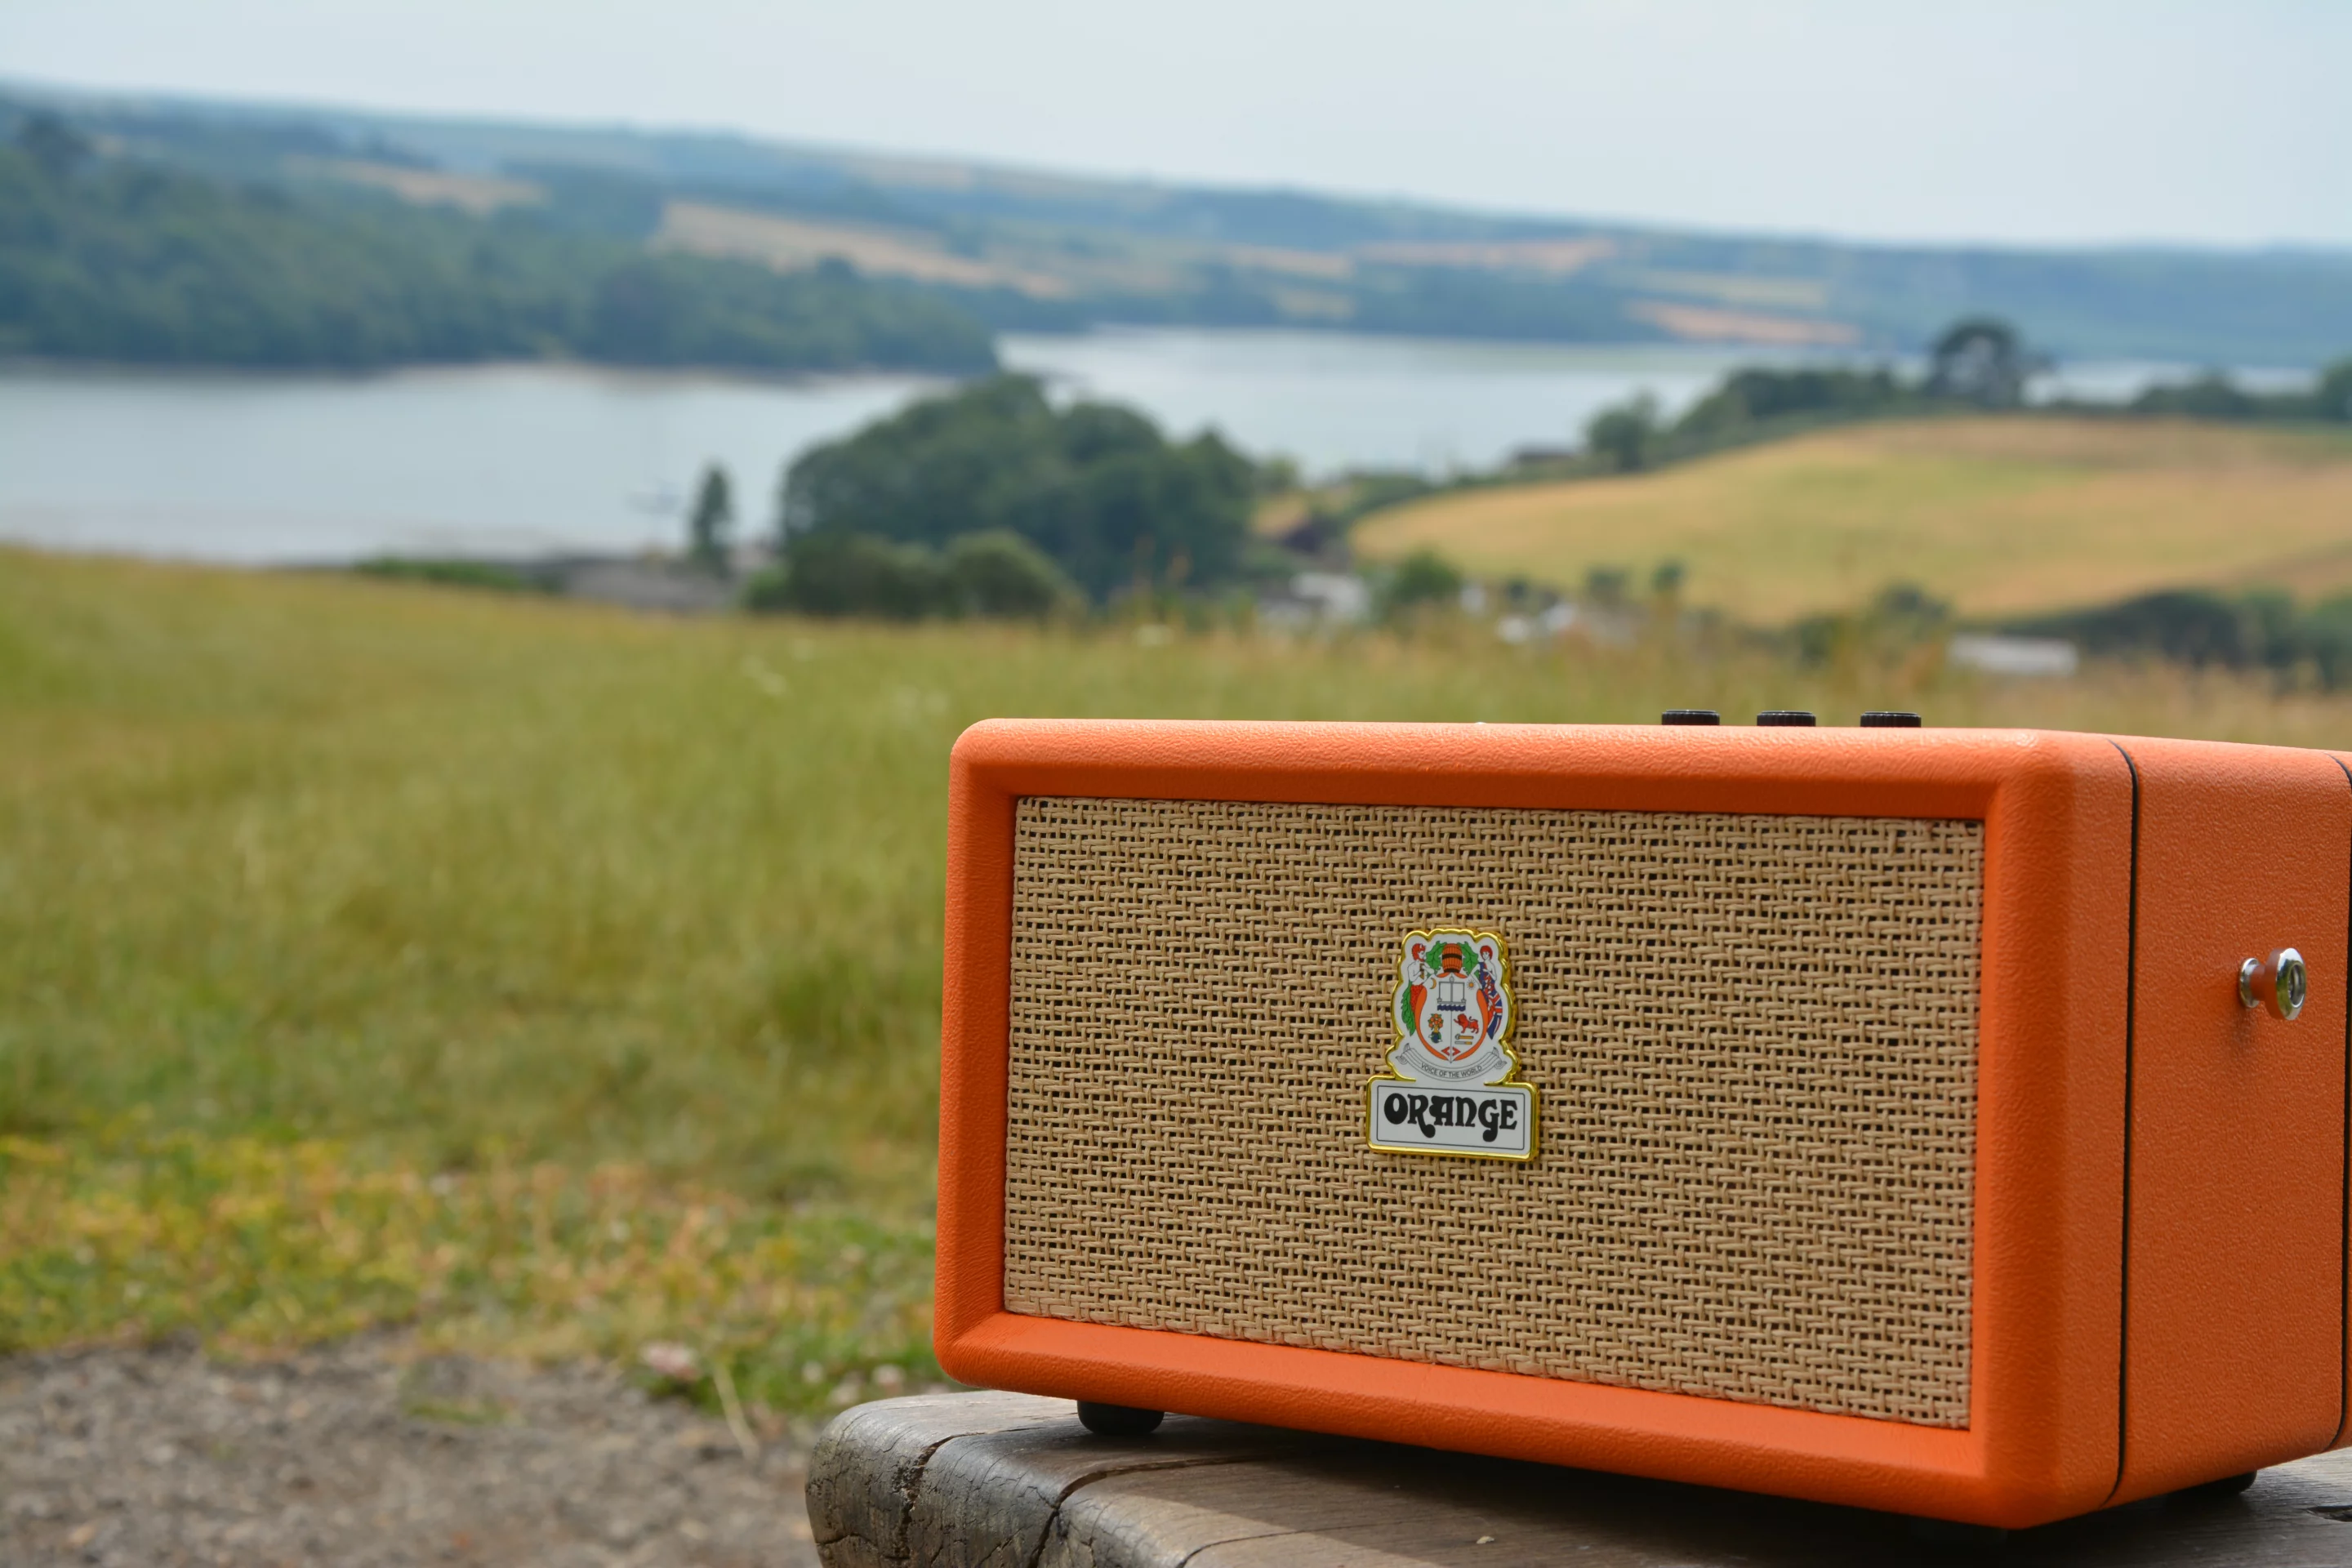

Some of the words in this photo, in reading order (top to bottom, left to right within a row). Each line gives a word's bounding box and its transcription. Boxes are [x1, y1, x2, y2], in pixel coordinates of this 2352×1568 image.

[1421, 1062, 1437, 1075] VOICE
[1460, 1065, 1482, 1077] WORLD
[1383, 1093, 1517, 1142] ORANGE
